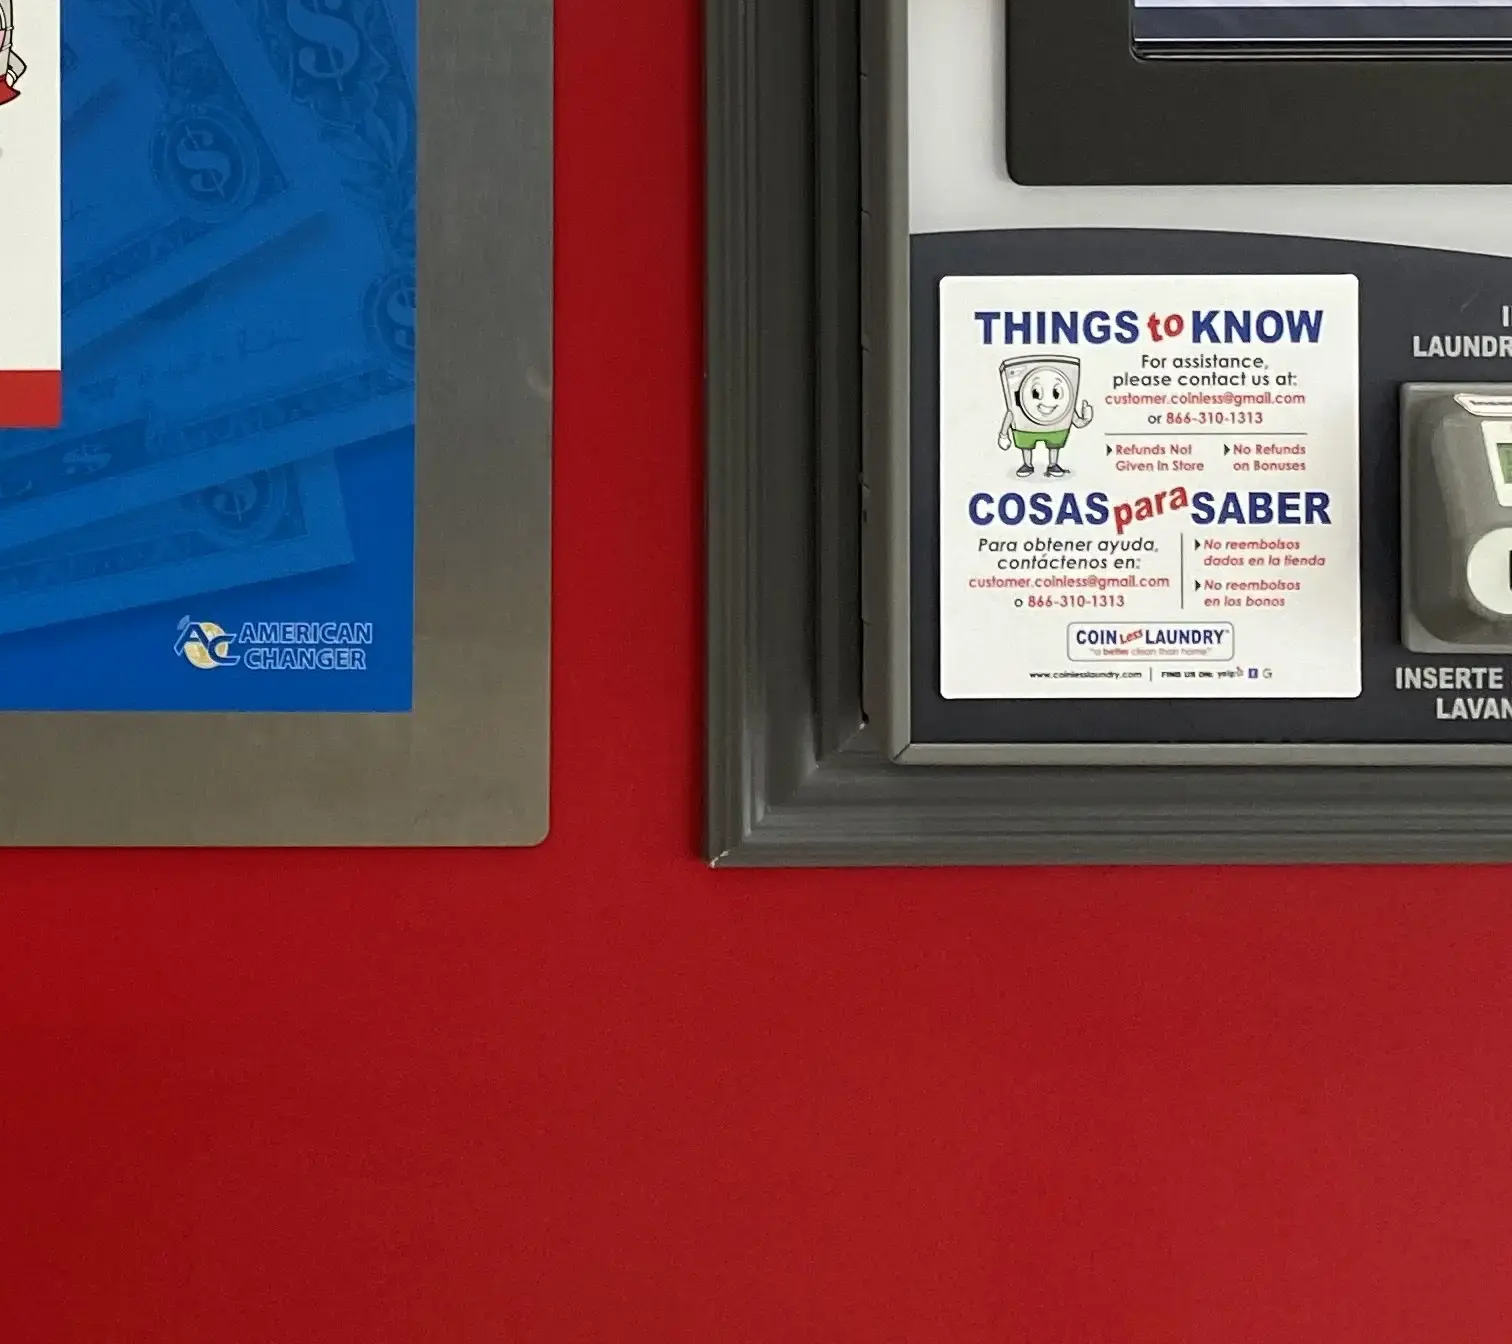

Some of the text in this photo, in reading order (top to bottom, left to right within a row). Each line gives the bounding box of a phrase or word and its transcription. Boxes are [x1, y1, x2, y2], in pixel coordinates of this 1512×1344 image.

[974, 310, 1323, 344] THINGS to KNOW
[1142, 355, 1270, 370] For assistance,
[1113, 372, 1297, 389] please contact us at:
[1105, 392, 1306, 407] customer.coinless@gmail.com
[1148, 411, 1263, 425] or 866-310-1313
[969, 487, 1332, 535] COSAS para SABER
[978, 538, 1159, 555] Para obtener ayuda,
[1204, 539, 1300, 551] No reembolsos
[997, 554, 1141, 570] contáctenos en:
[1204, 555, 1326, 567] dados en la tienda
[1014, 595, 1125, 608] o 866-310-1313
[239, 622, 373, 645] AMERICAN
[244, 647, 367, 670] CHANGER
[1396, 667, 1503, 690] INSERTE
